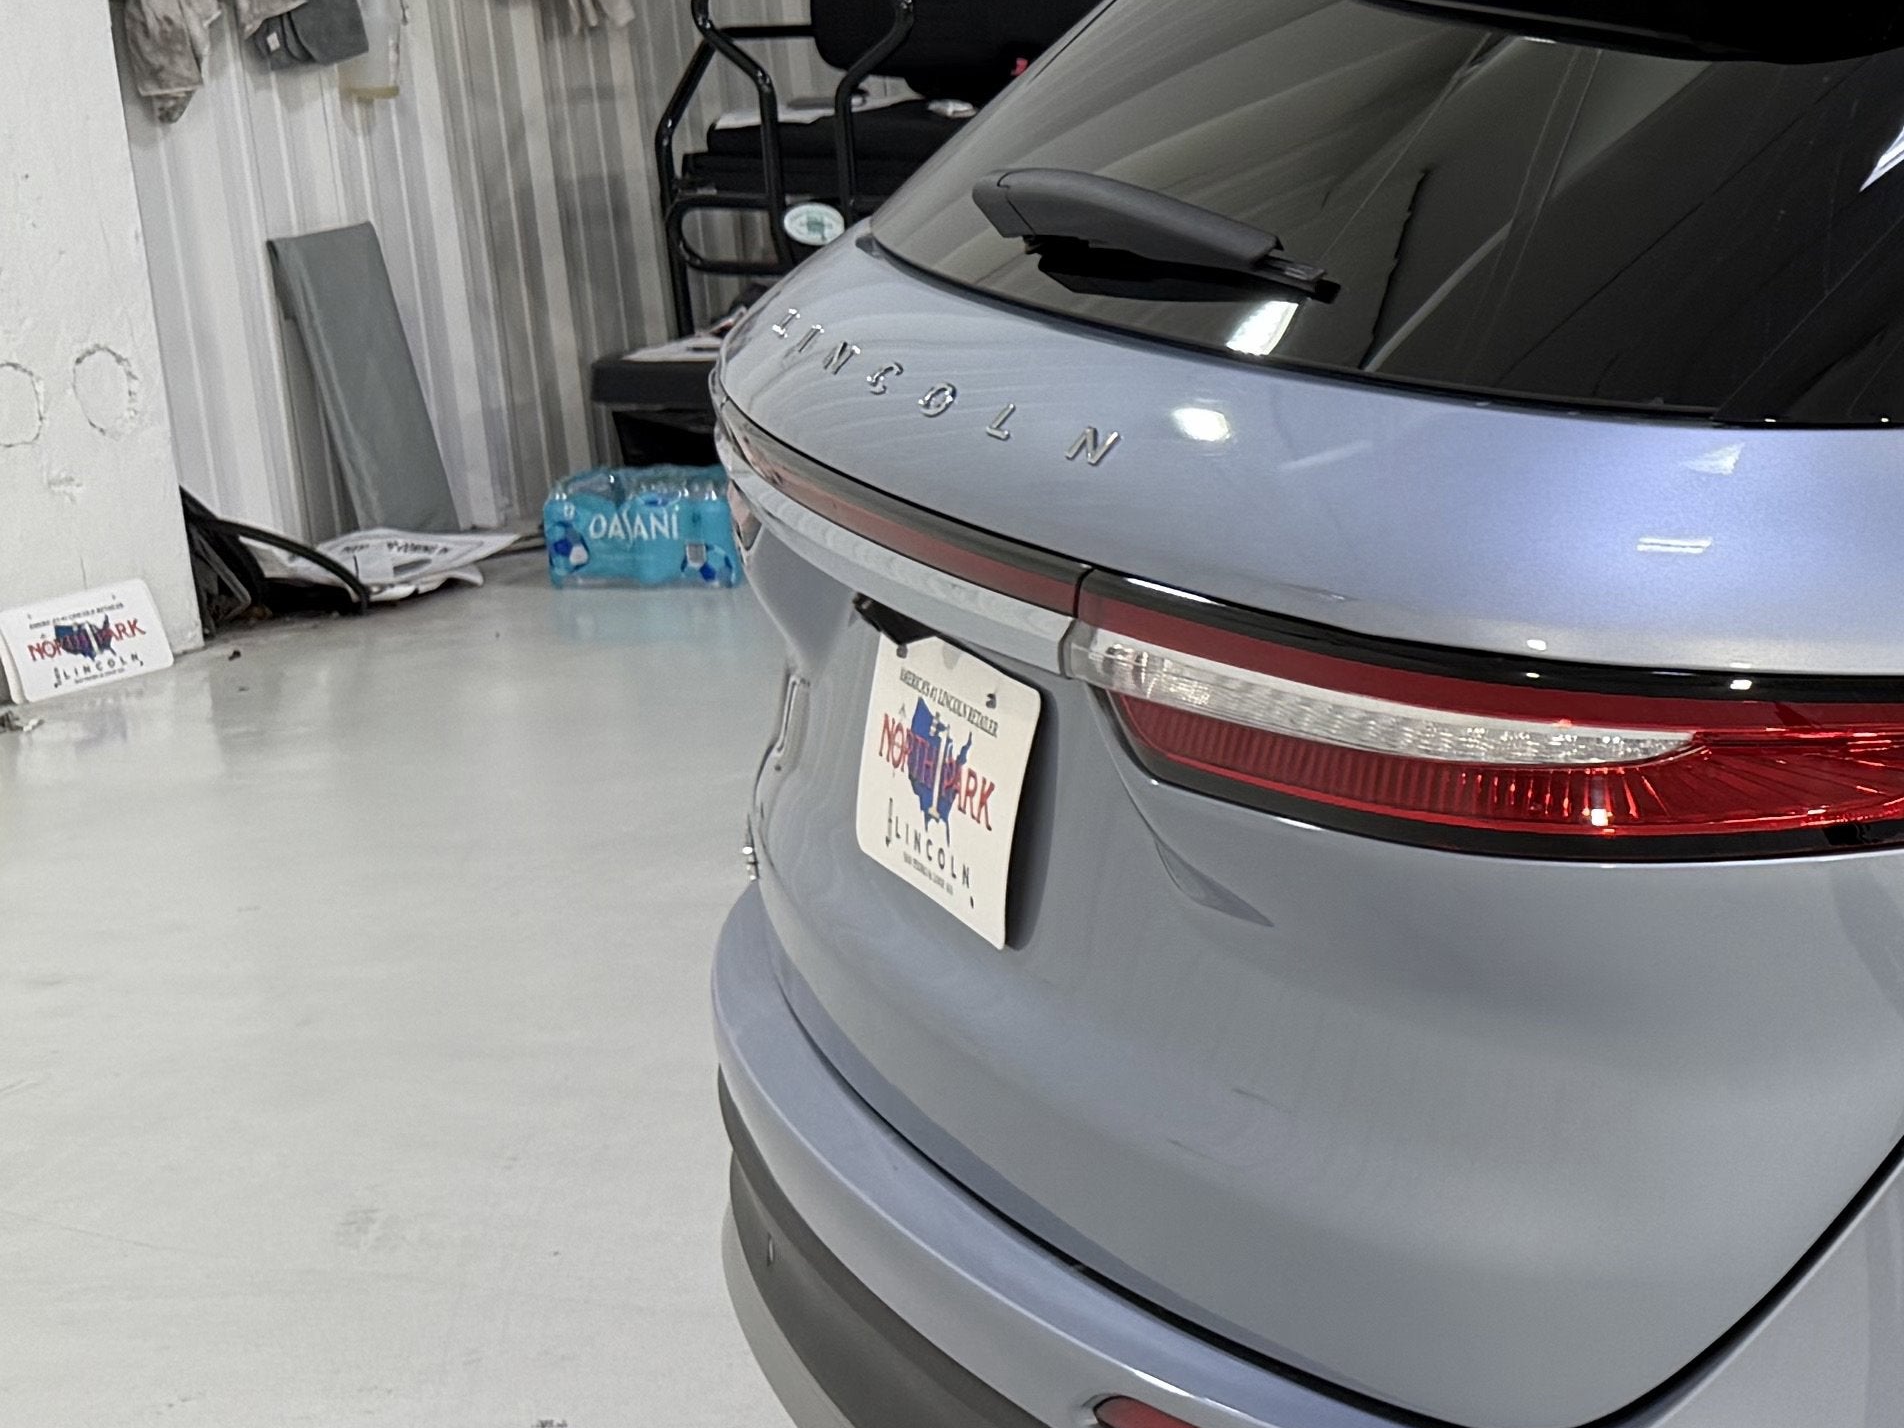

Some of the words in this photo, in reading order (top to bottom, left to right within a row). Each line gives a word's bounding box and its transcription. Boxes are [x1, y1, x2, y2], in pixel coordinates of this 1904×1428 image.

[772, 308, 1122, 466] LINCOLN
[588, 504, 681, 551] DASANI
[63, 652, 140, 681] LINCOLN
[878, 712, 939, 789] NORTH
[941, 755, 997, 832] PARK
[894, 815, 971, 889] LINCOLN
